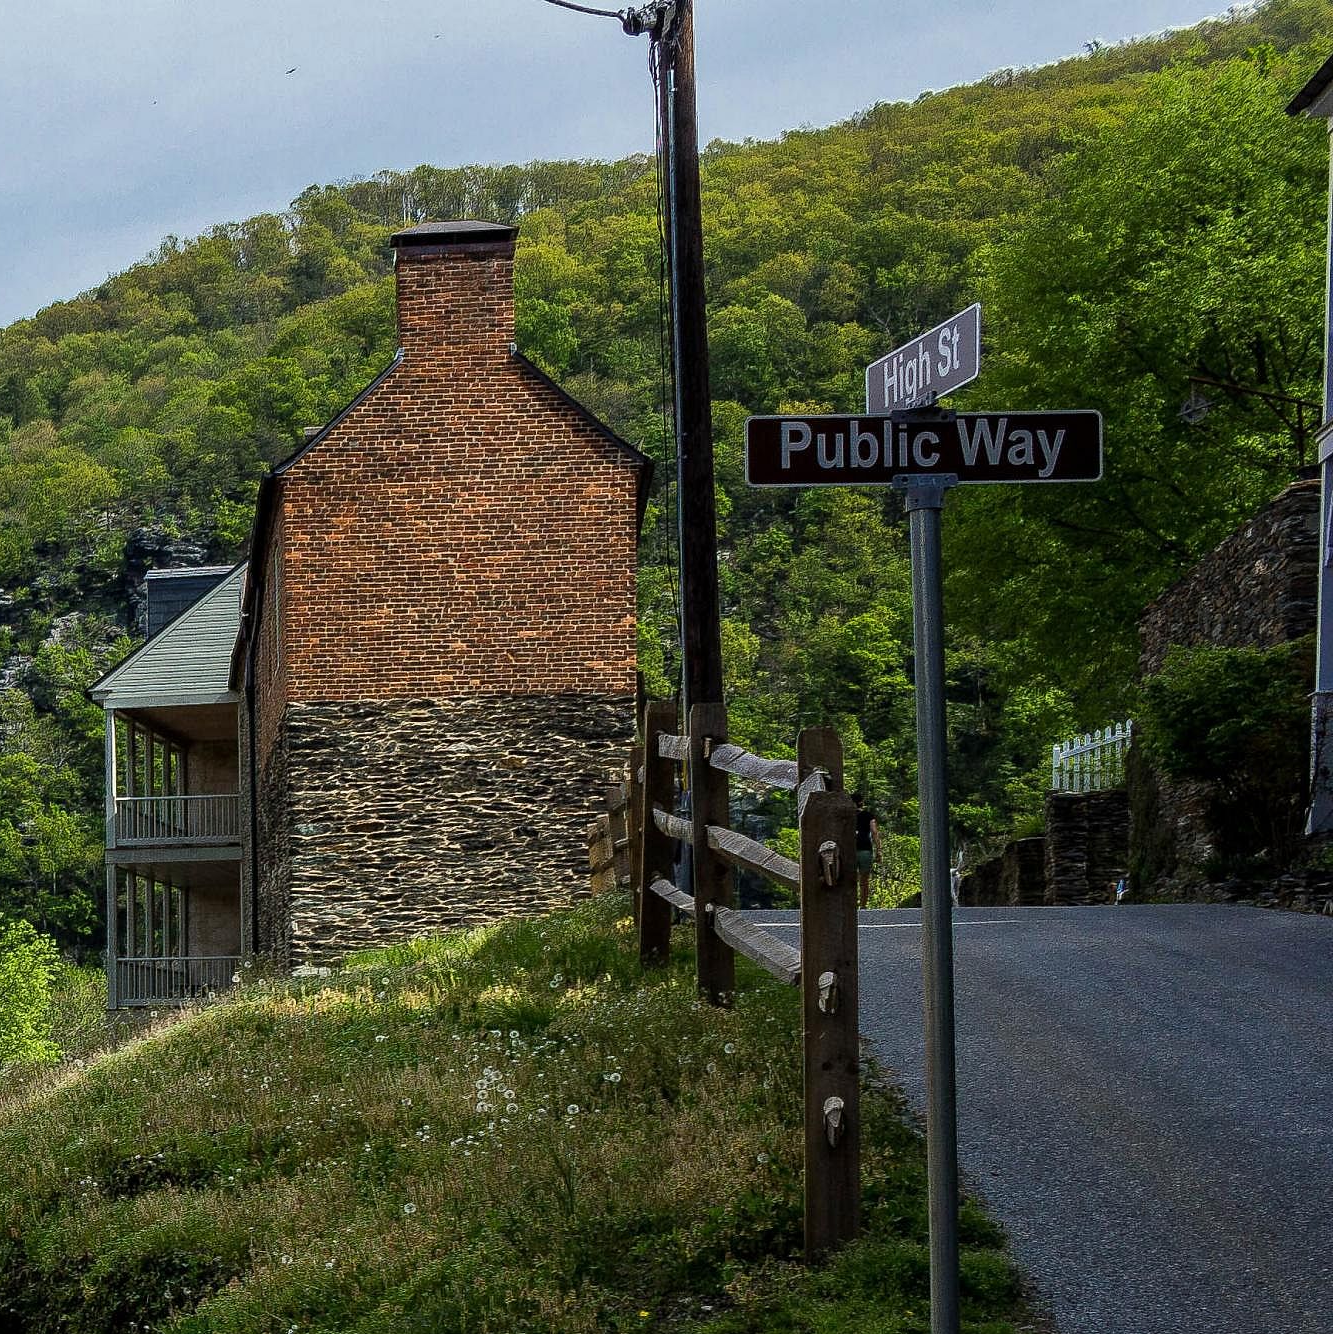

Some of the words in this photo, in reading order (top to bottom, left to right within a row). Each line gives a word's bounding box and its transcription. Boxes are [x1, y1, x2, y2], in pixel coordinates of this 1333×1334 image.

[883, 341, 931, 408] High
[937, 322, 961, 377] St
[781, 418, 941, 470] Public
[956, 418, 1066, 478] Way
